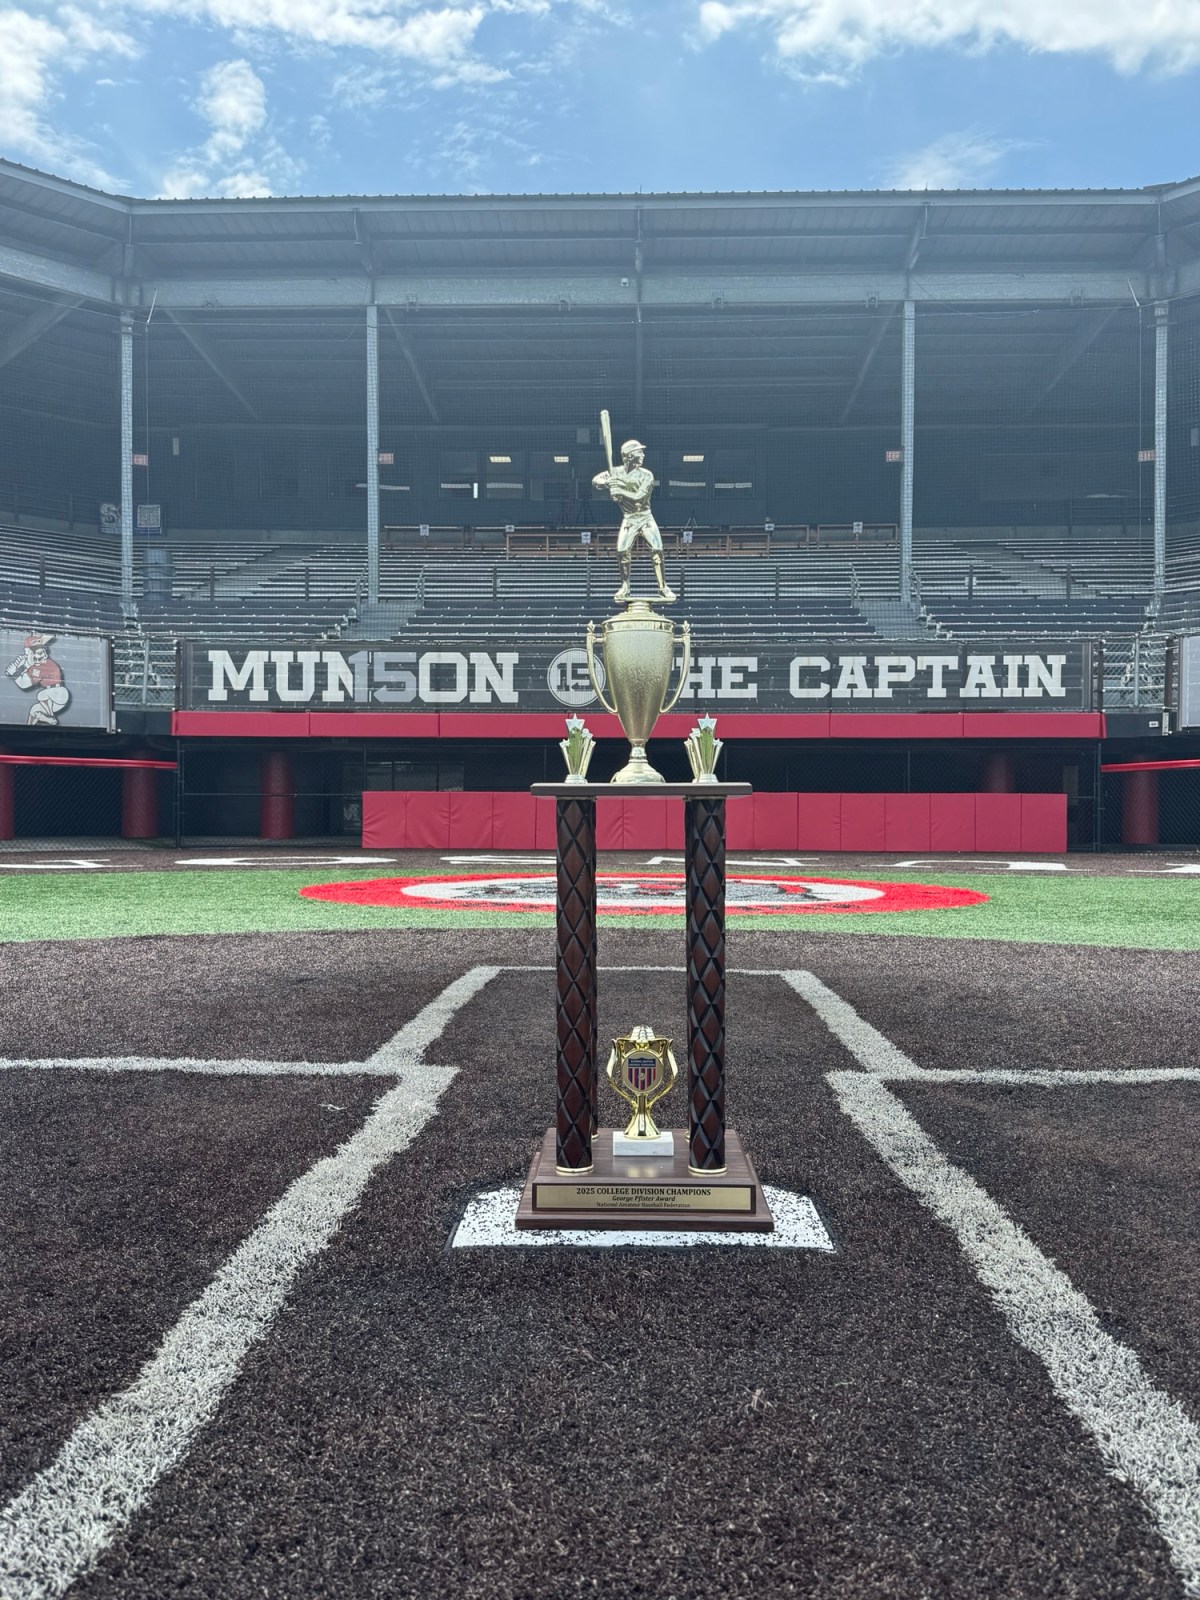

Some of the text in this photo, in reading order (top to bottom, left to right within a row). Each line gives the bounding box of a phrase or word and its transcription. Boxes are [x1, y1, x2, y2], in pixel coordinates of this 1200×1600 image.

[671, 656, 758, 699] HE
[789, 655, 1067, 699] CAPTAIN
[576, 1187, 711, 1196] 2025 COLLEGE DIVISION CHAMPIONS
